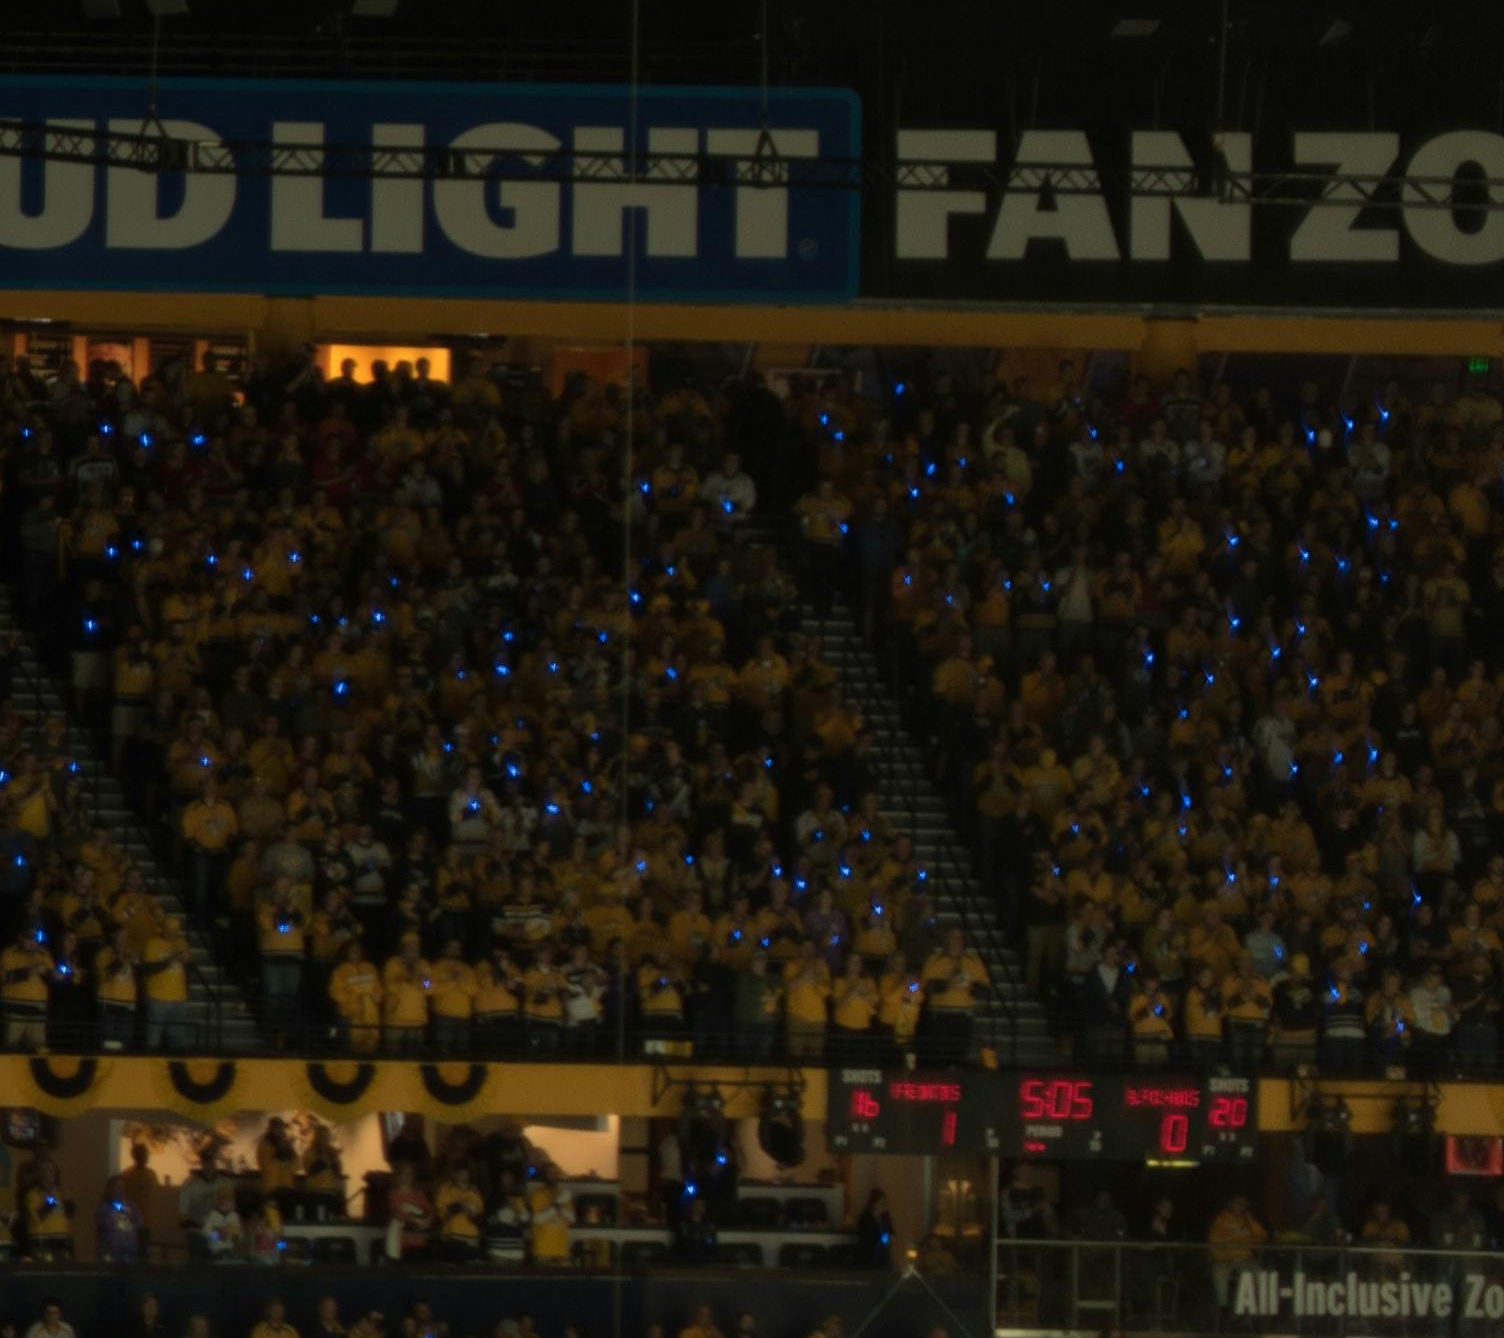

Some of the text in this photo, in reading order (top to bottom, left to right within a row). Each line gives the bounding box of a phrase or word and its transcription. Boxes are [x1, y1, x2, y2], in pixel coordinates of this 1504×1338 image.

[268, 119, 821, 261] LIGHT
[894, 127, 1504, 266] FAN ZO
[1020, 1079, 1094, 1121] 5:05
[1208, 1097, 1249, 1127] 20
[1161, 1114, 1189, 1154] 0
[1234, 1270, 1455, 1317] All-Inclusive
